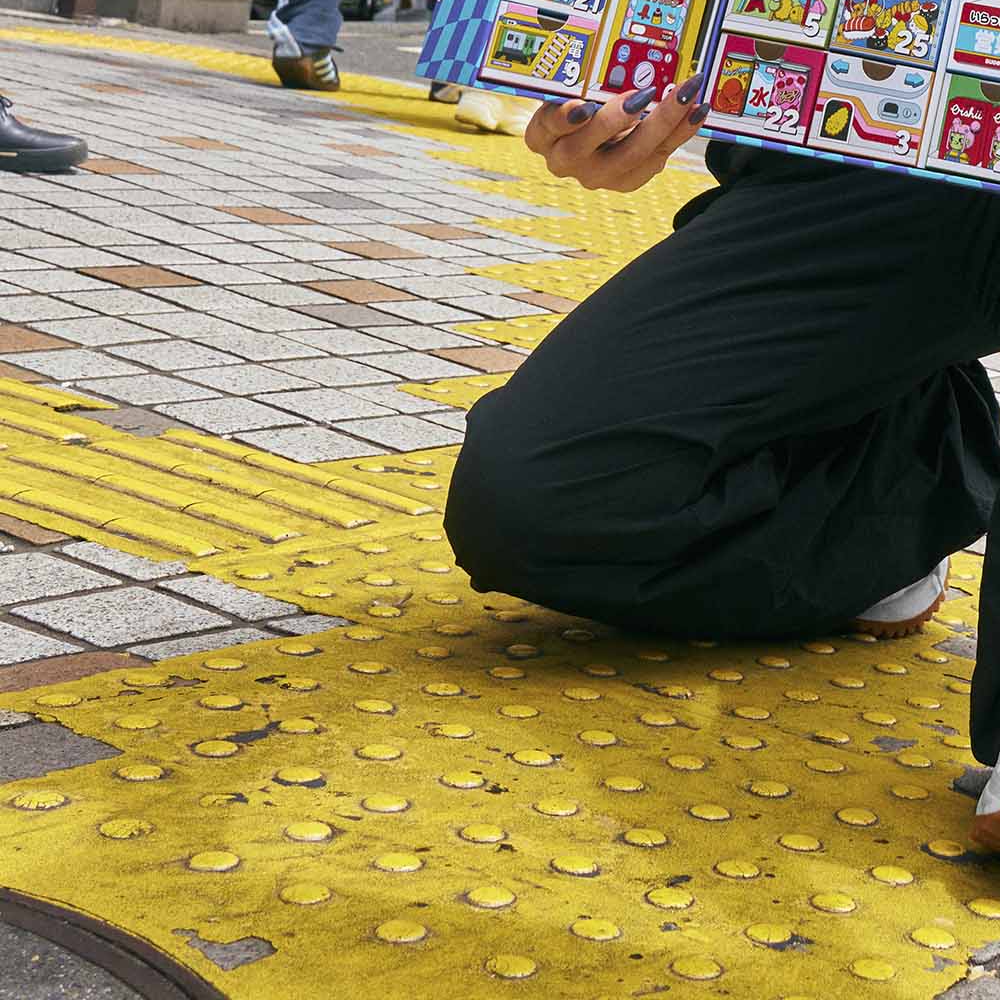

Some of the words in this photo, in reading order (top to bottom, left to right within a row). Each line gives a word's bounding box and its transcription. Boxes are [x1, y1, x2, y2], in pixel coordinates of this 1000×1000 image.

[803, 15, 820, 38] 5
[894, 30, 931, 58] 25
[564, 59, 582, 86] 9
[749, 86, 768, 108] 水
[763, 106, 800, 135] 22
[950, 103, 984, 121] Oishii
[894, 130, 912, 156] 3
